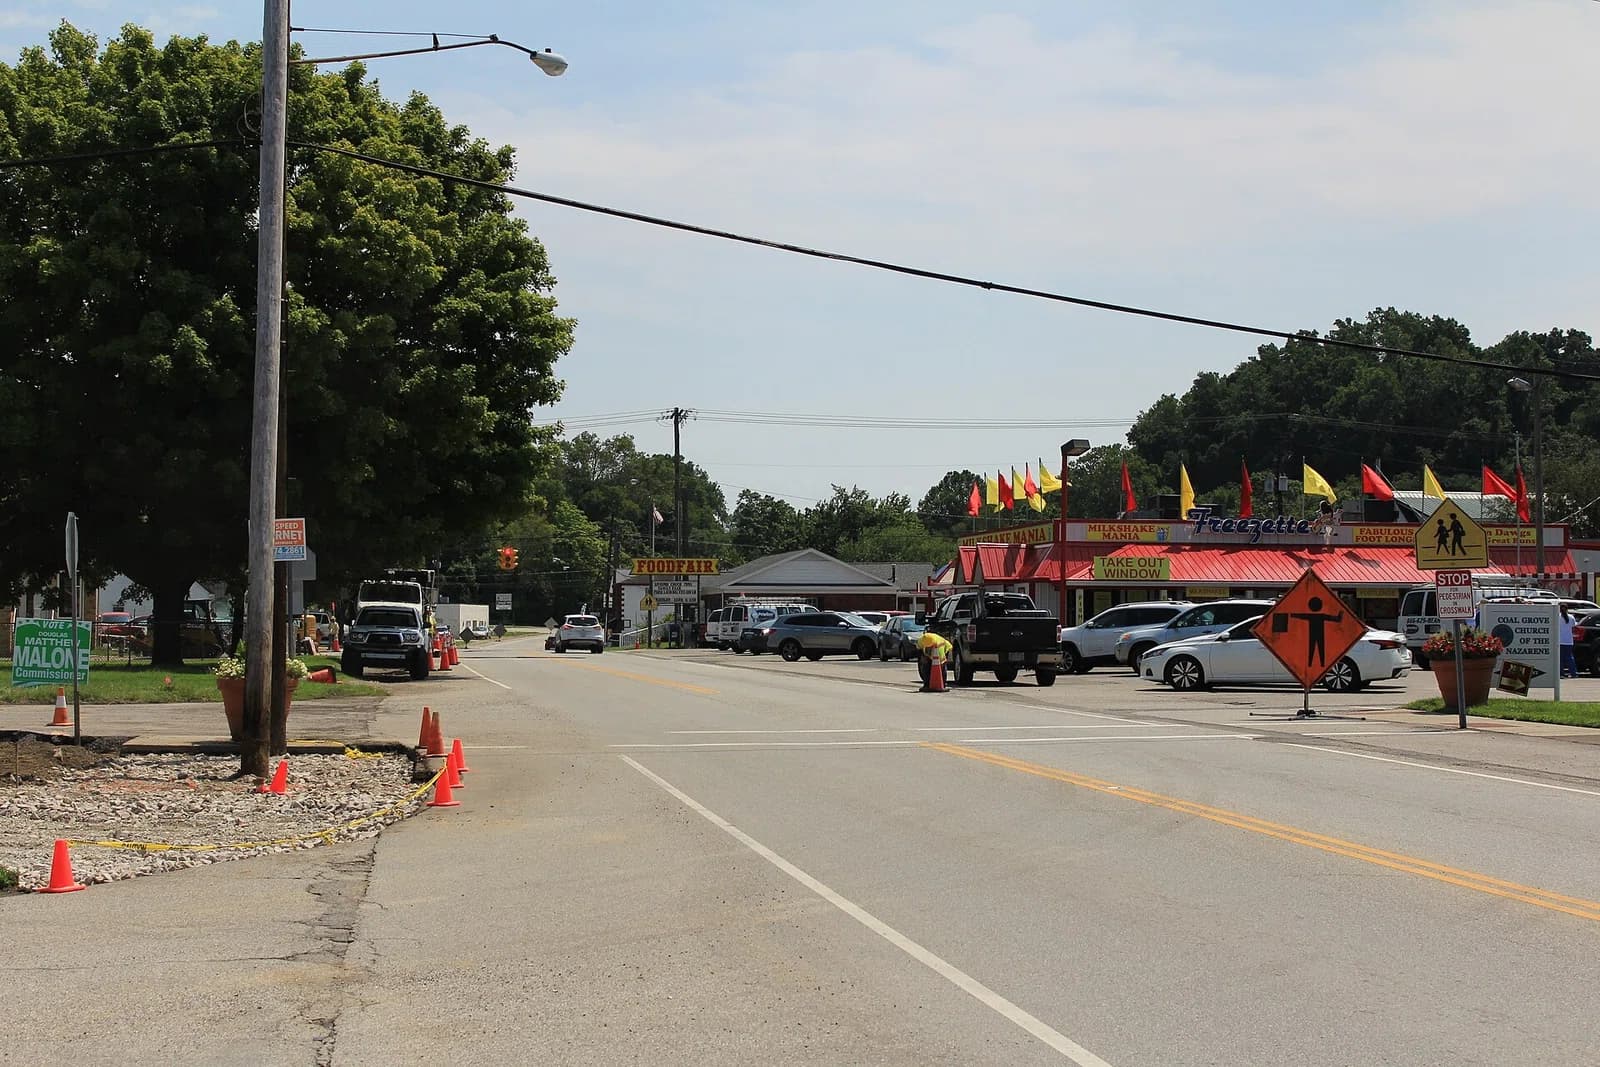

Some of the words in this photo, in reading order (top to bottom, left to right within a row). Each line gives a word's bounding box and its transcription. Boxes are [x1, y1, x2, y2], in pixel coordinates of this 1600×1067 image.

[1088, 524, 1156, 533] MILKSHAKE
[1187, 507, 1311, 543] Freezette
[1013, 527, 1047, 544] MANIA
[1102, 532, 1141, 540] MANIA
[1359, 527, 1414, 536] FABULOUS
[1355, 535, 1383, 543] FOOT
[1384, 536, 1416, 544] LONG
[1100, 557, 1134, 568] TAKE
[1137, 557, 1165, 568] OUT
[1103, 568, 1161, 579] WINDOW
[1437, 573, 1470, 586] STOP
[1439, 592, 1472, 601] PEDESTRIAN
[1440, 606, 1472, 615] CROSSWALK
[1497, 616, 1520, 624] COAL
[1521, 616, 1550, 624] GROVE
[42, 620, 66, 630] VOTE
[1505, 647, 1550, 655] NAZARENE
[14, 645, 90, 670] MALONE
